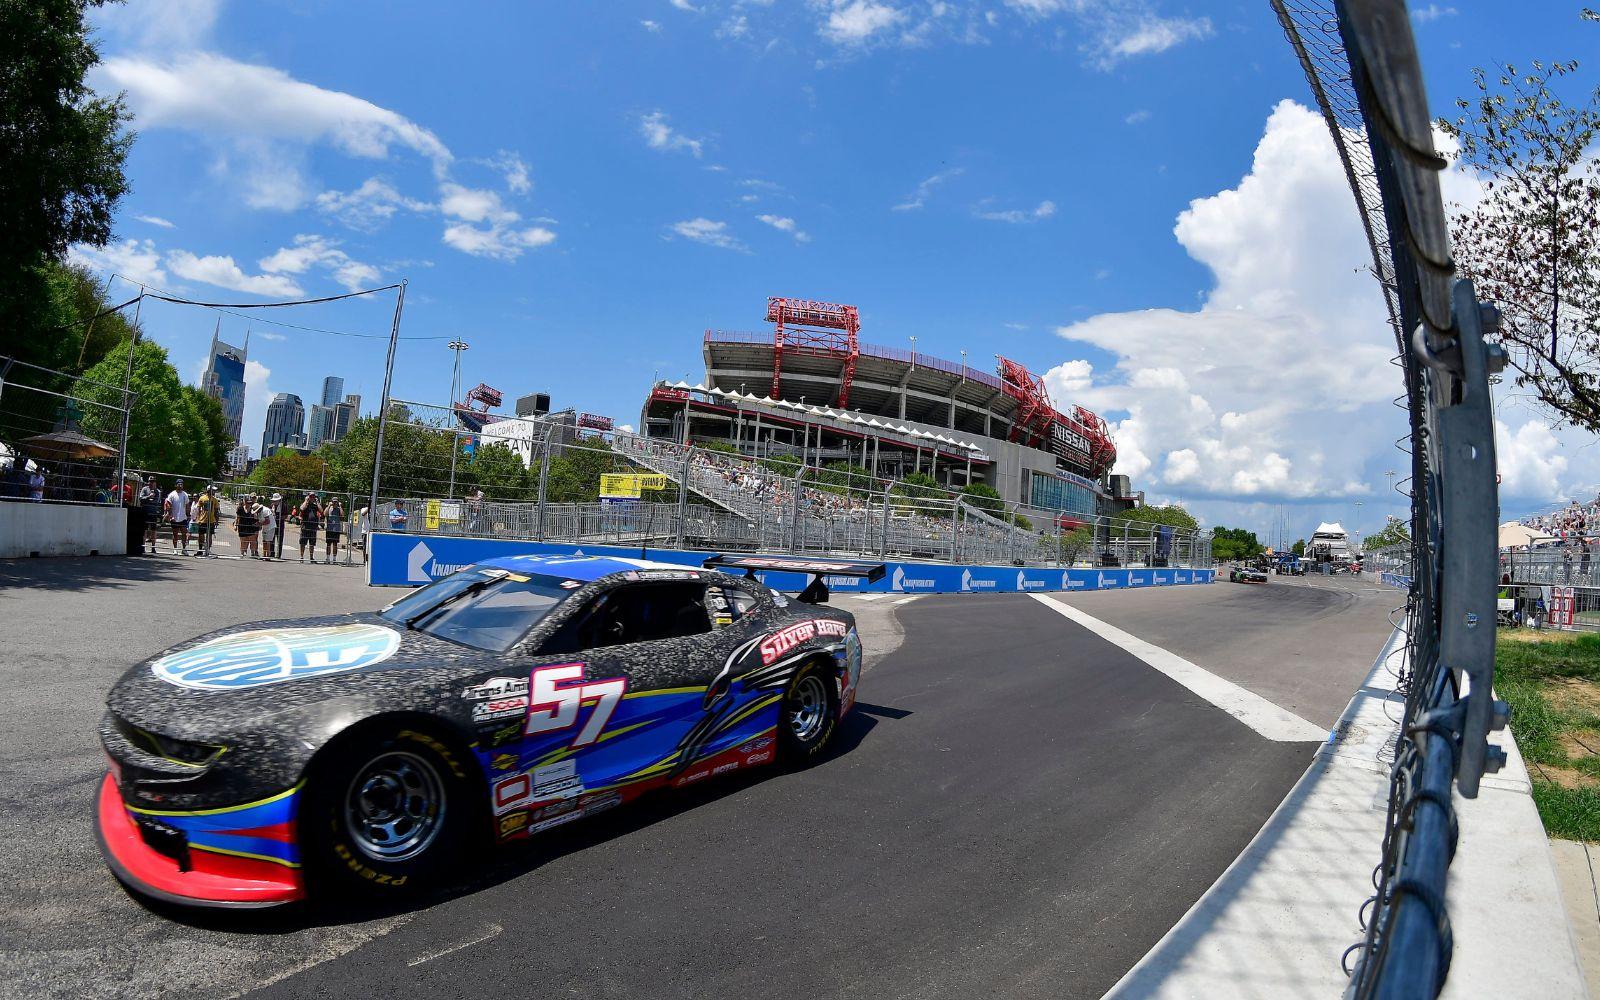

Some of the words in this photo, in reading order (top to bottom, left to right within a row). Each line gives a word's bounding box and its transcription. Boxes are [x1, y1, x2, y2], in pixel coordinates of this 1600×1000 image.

[1054, 423, 1090, 454] NISSAN
[759, 619, 815, 667] Silver
[815, 618, 847, 638] Hare
[488, 698, 525, 712] SCCA
[525, 662, 627, 751] 57
